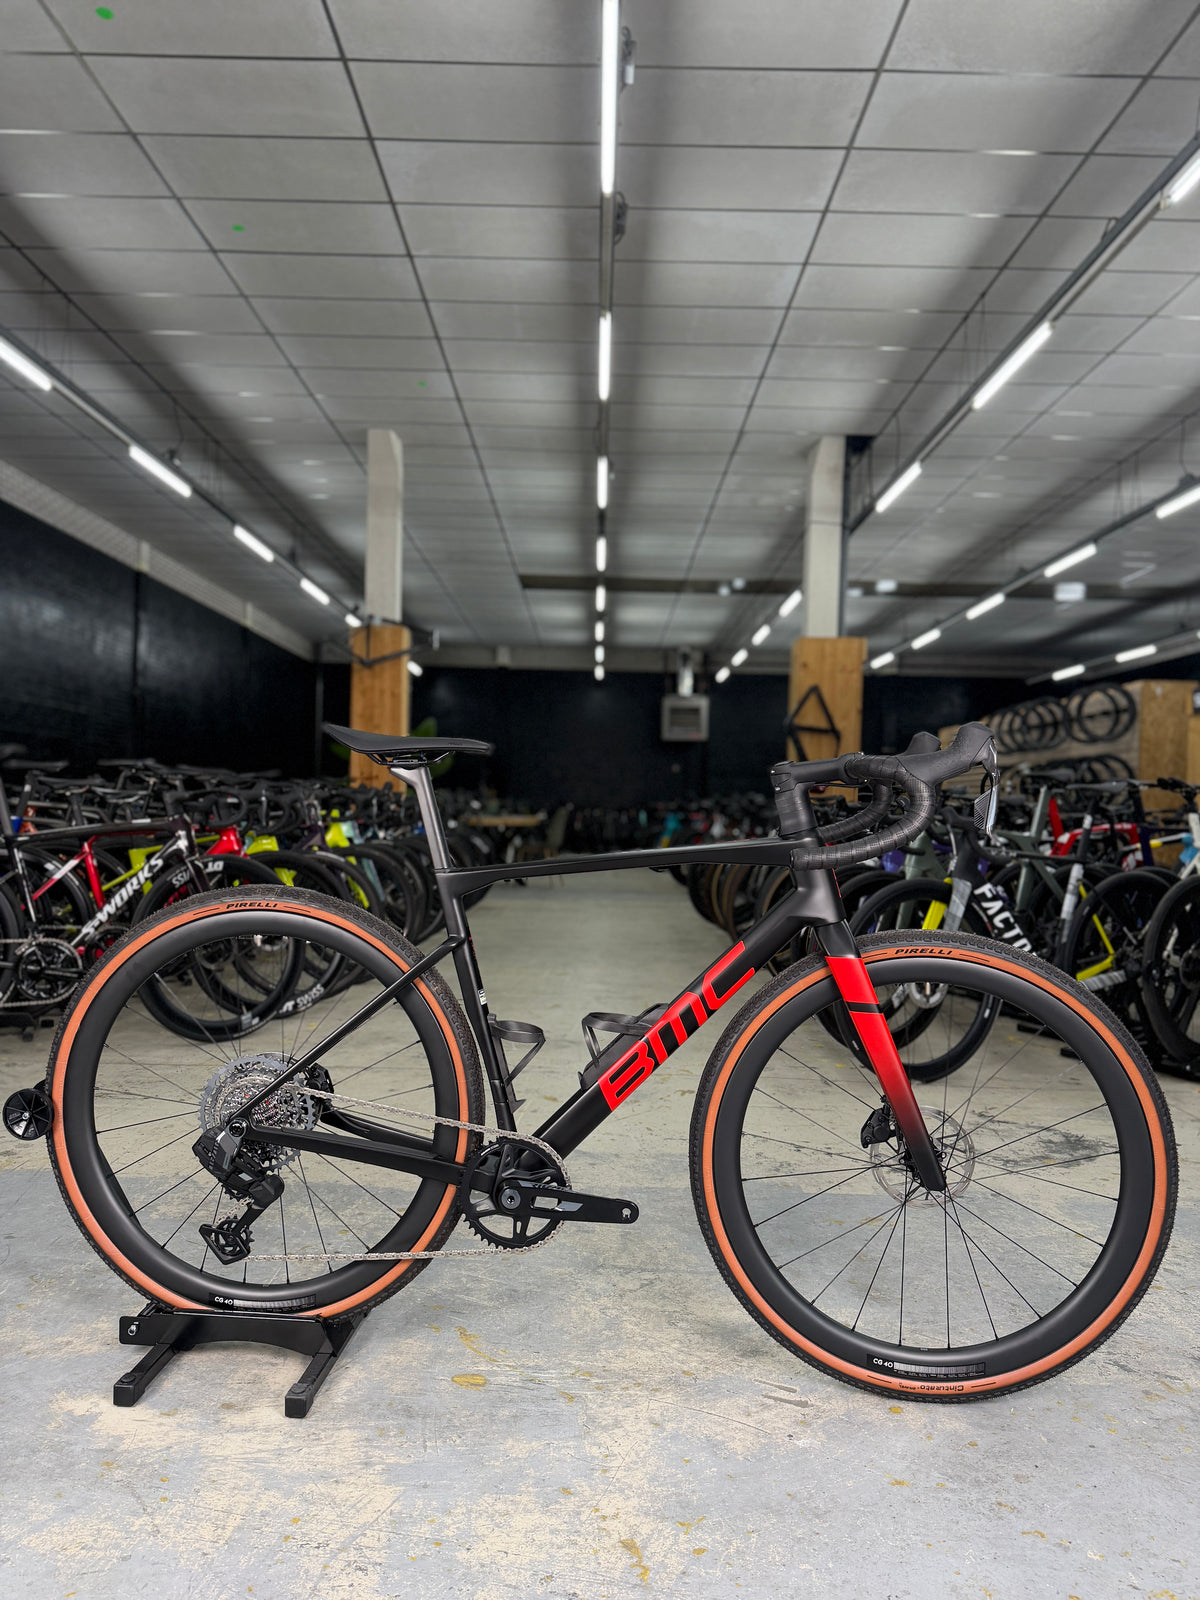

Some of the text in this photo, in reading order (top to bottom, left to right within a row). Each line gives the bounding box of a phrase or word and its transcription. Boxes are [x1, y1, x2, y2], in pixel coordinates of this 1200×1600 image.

[82, 856, 164, 941] S-WORKS
[973, 883, 1037, 957] FACTO
[296, 983, 325, 1008] SWISS
[598, 940, 755, 1112] BMC
[872, 1358, 883, 1366] CG
